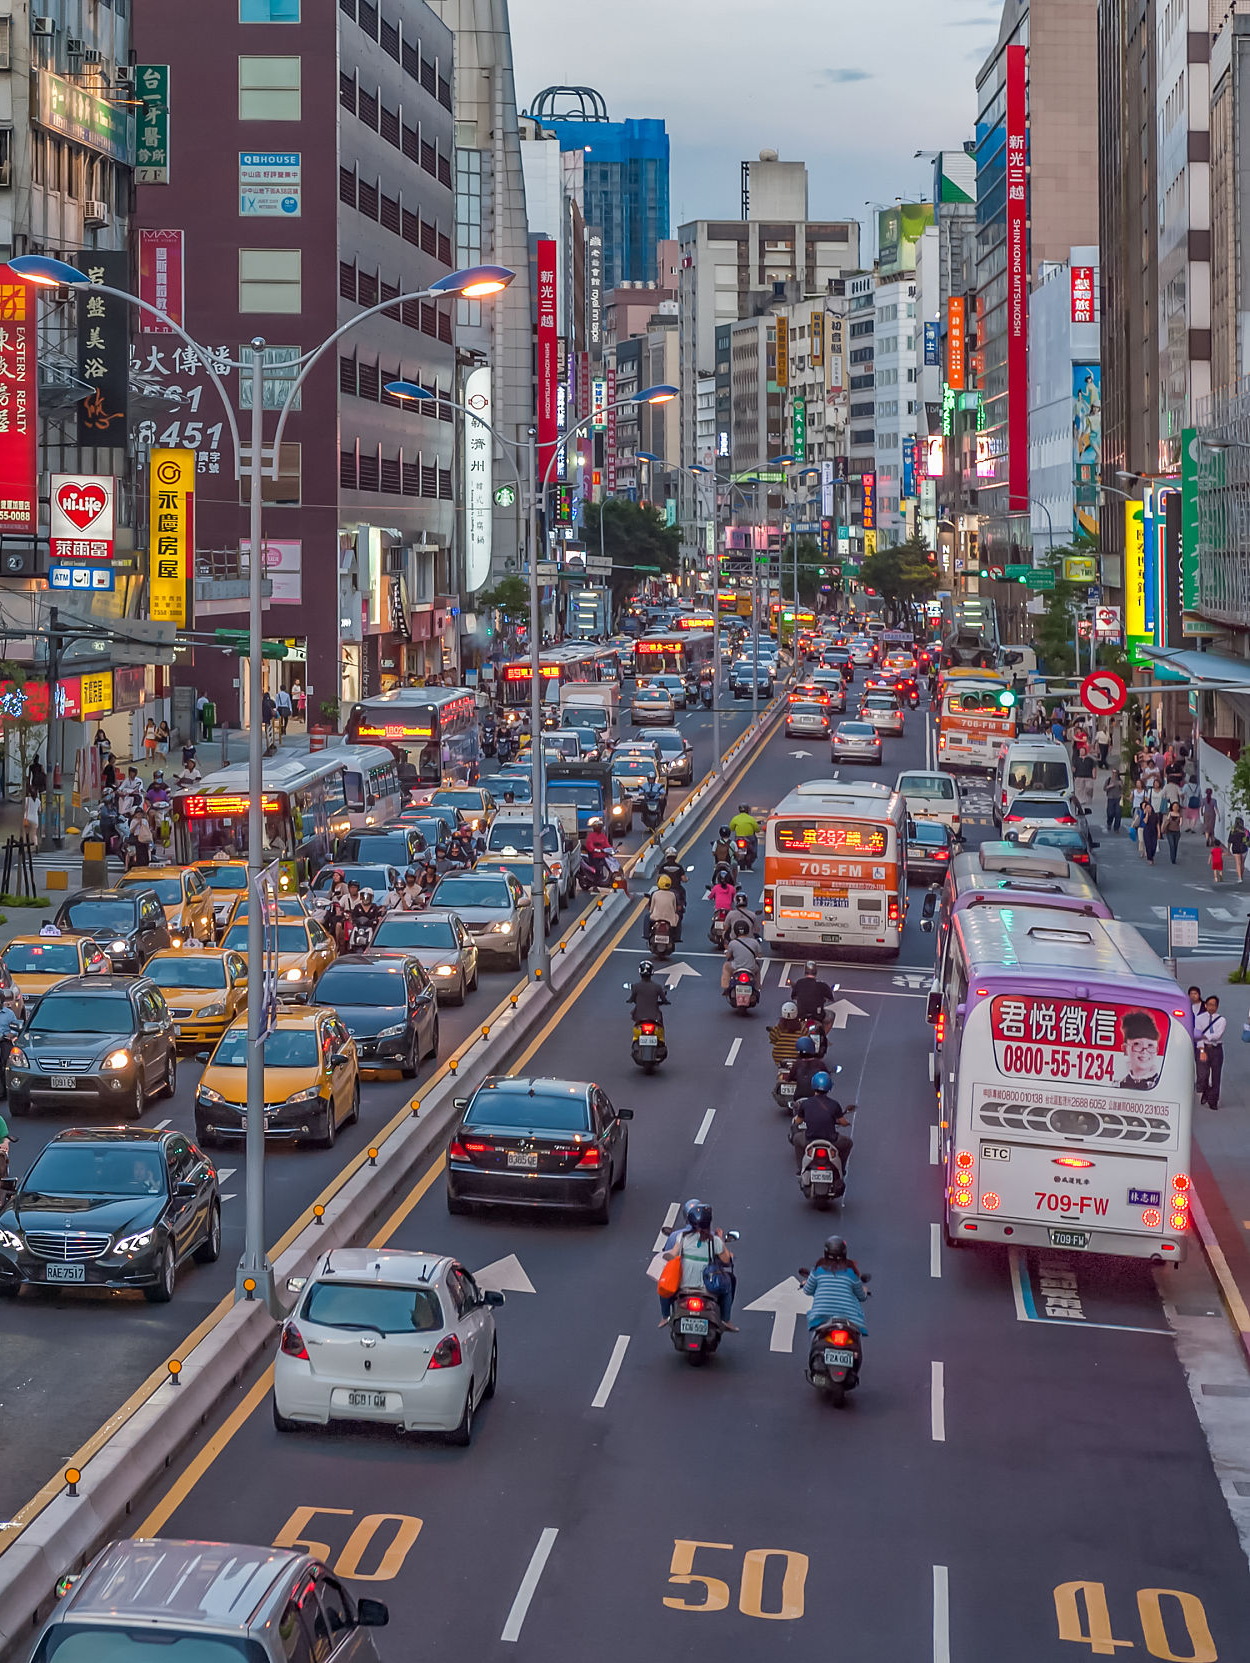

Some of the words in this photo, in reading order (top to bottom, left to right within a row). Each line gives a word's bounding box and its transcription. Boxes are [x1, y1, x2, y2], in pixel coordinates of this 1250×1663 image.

[1009, 135, 1025, 200] 新光三越
[143, 231, 178, 239] MAX
[1013, 219, 1021, 244] SHIN
[1013, 246, 1021, 273] KONG
[540, 270, 554, 328] 新光三越
[1013, 276, 1021, 337] MITSUKOSHI
[16, 326, 27, 382] EASTERN
[16, 390, 27, 435] REALTY
[56, 540, 108, 557] 萊爾富
[158, 490, 179, 579] 永慶房屋
[942, 544, 950, 573] NET
[54, 573, 69, 582] ATM
[800, 862, 862, 877] 705-FM
[1003, 1044, 1115, 1082] 0800-55-1234
[983, 1147, 1009, 1159] ETC
[1034, 1191, 1110, 1217] 709-FW
[662, 1539, 810, 1621] 50
[1052, 1579, 1219, 1663] 40
